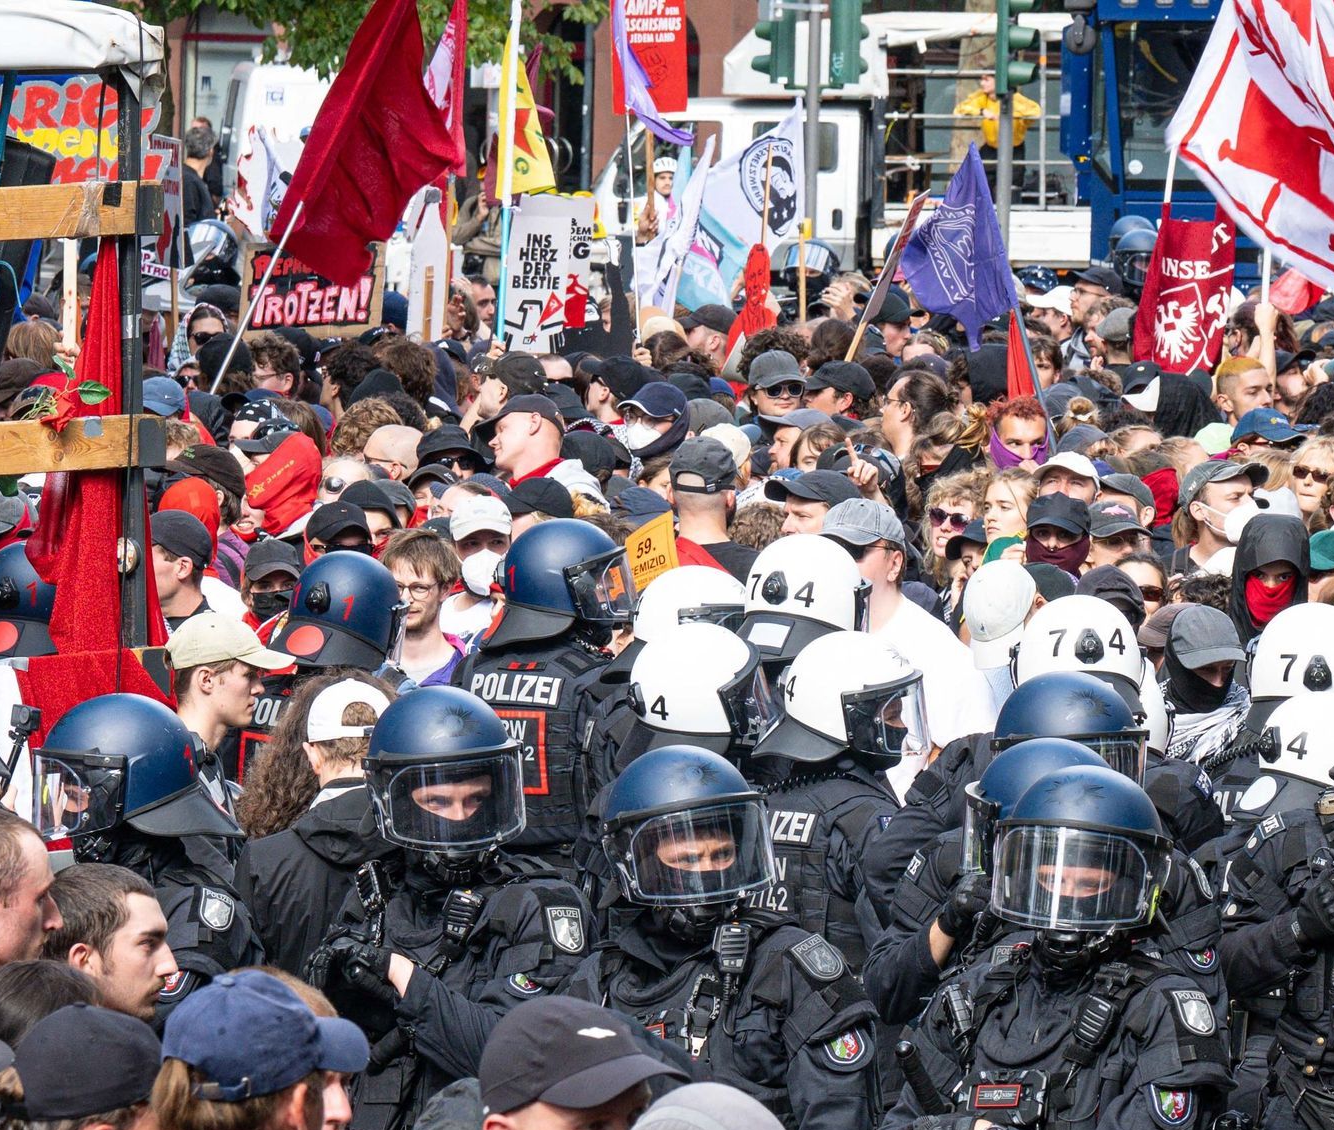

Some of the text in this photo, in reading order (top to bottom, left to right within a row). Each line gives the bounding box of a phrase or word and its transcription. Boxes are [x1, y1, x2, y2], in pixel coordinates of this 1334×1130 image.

[655, 32, 676, 43] LAND
[527, 233, 552, 248] INS
[519, 247, 558, 262] HERZ
[523, 262, 551, 276] DER
[512, 276, 560, 290] BESTIE
[250, 276, 374, 328] TROTZEN!
[636, 538, 657, 560] 59.
[508, 564, 516, 592] 1
[26, 581, 38, 608] 1
[750, 574, 815, 608] 7 4
[341, 596, 355, 621] 1
[1048, 627, 1126, 657] 7 4
[1279, 653, 1298, 682] 7
[470, 672, 564, 708] POLIZEI
[785, 675, 797, 703] 4
[650, 695, 669, 721] 4
[524, 746, 535, 761] 2
[1286, 731, 1308, 760] 4
[206, 889, 232, 906] POLIZEI
[551, 910, 578, 919] POLIZEI
[796, 935, 820, 954] POLIZEI
[1178, 990, 1207, 1001] POLIZEI
